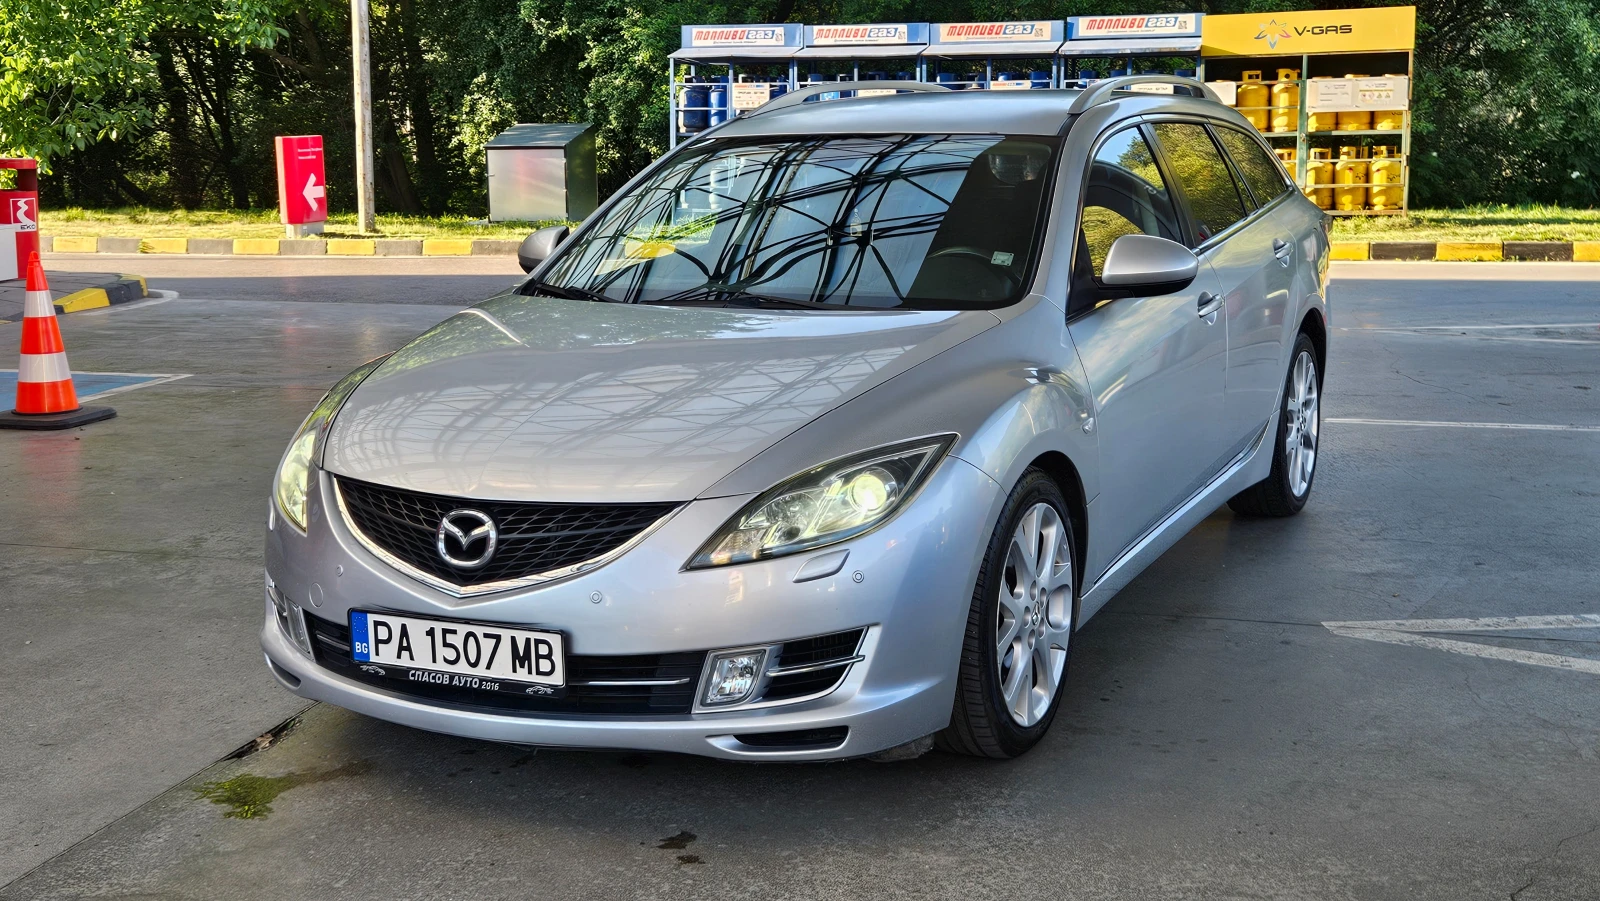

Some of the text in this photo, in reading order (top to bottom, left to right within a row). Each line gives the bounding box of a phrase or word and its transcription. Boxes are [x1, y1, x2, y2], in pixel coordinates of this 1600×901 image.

[1294, 24, 1353, 36] V-GAS
[355, 641, 368, 654] BG
[373, 620, 556, 677] PA 1507 MB
[408, 669, 500, 691] СПАСОВ АУТО 2016
